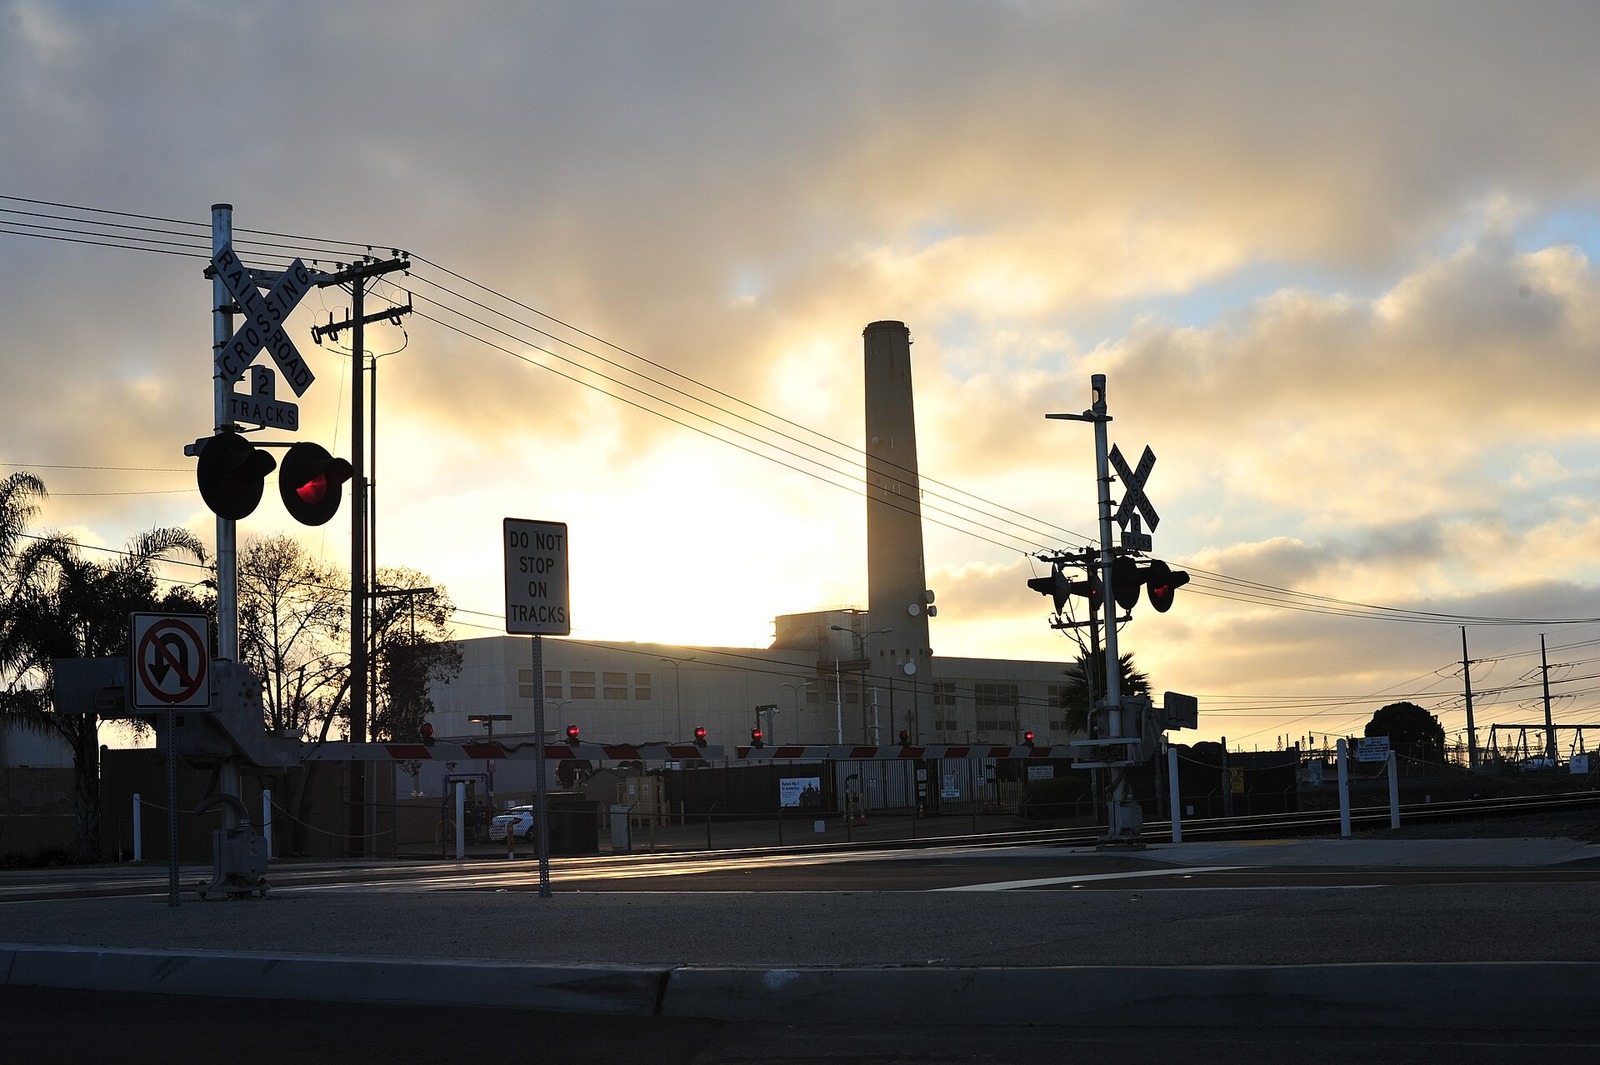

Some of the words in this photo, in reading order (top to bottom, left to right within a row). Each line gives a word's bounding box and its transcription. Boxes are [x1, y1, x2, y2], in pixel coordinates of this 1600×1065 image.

[223, 266, 309, 375] CROSSING
[258, 374, 269, 395] 2
[231, 399, 295, 425] TRACKS
[1118, 450, 1153, 525] CROSSING
[1133, 518, 1139, 530] 2
[510, 531, 529, 549] DO
[536, 533, 562, 551] NOT
[1123, 535, 1151, 548] TRACKS
[520, 556, 554, 574] STOP
[528, 581, 547, 598] ON
[511, 604, 565, 623] TRACKS
